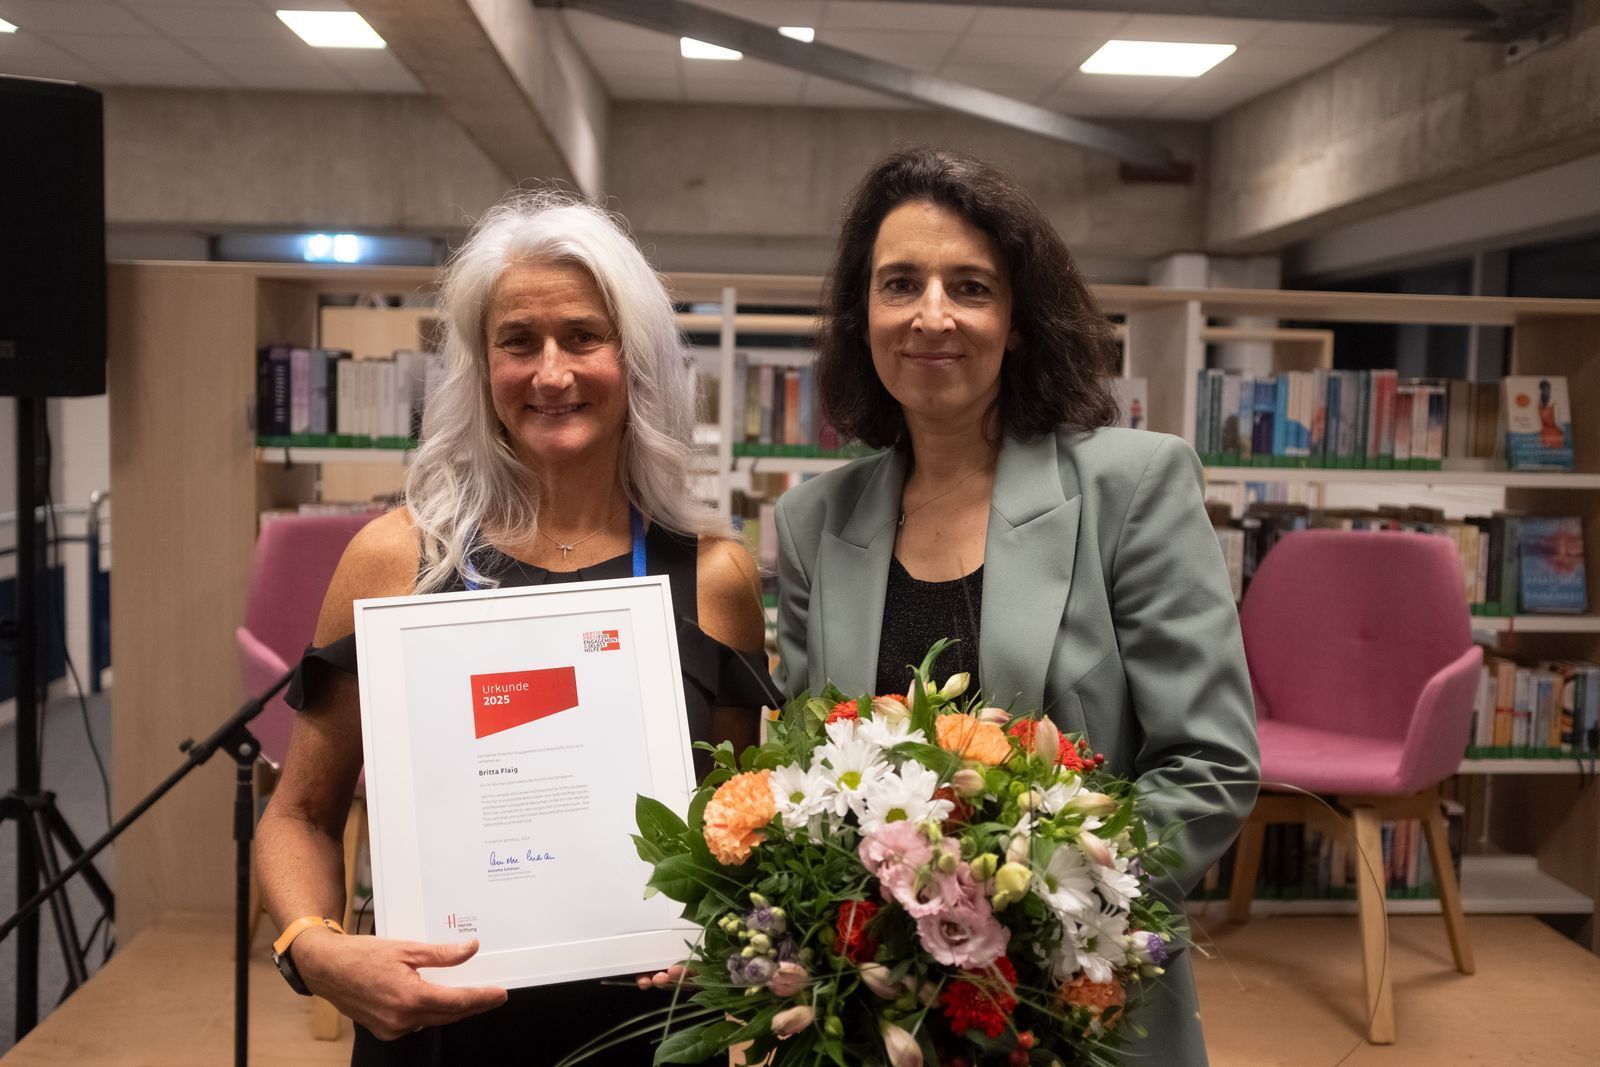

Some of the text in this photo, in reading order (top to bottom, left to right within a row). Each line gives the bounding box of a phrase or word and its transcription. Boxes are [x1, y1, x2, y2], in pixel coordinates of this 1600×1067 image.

[482, 682, 529, 694] Urkunde
[483, 695, 510, 706] 2025
[478, 766, 519, 777] Britta Flaig
